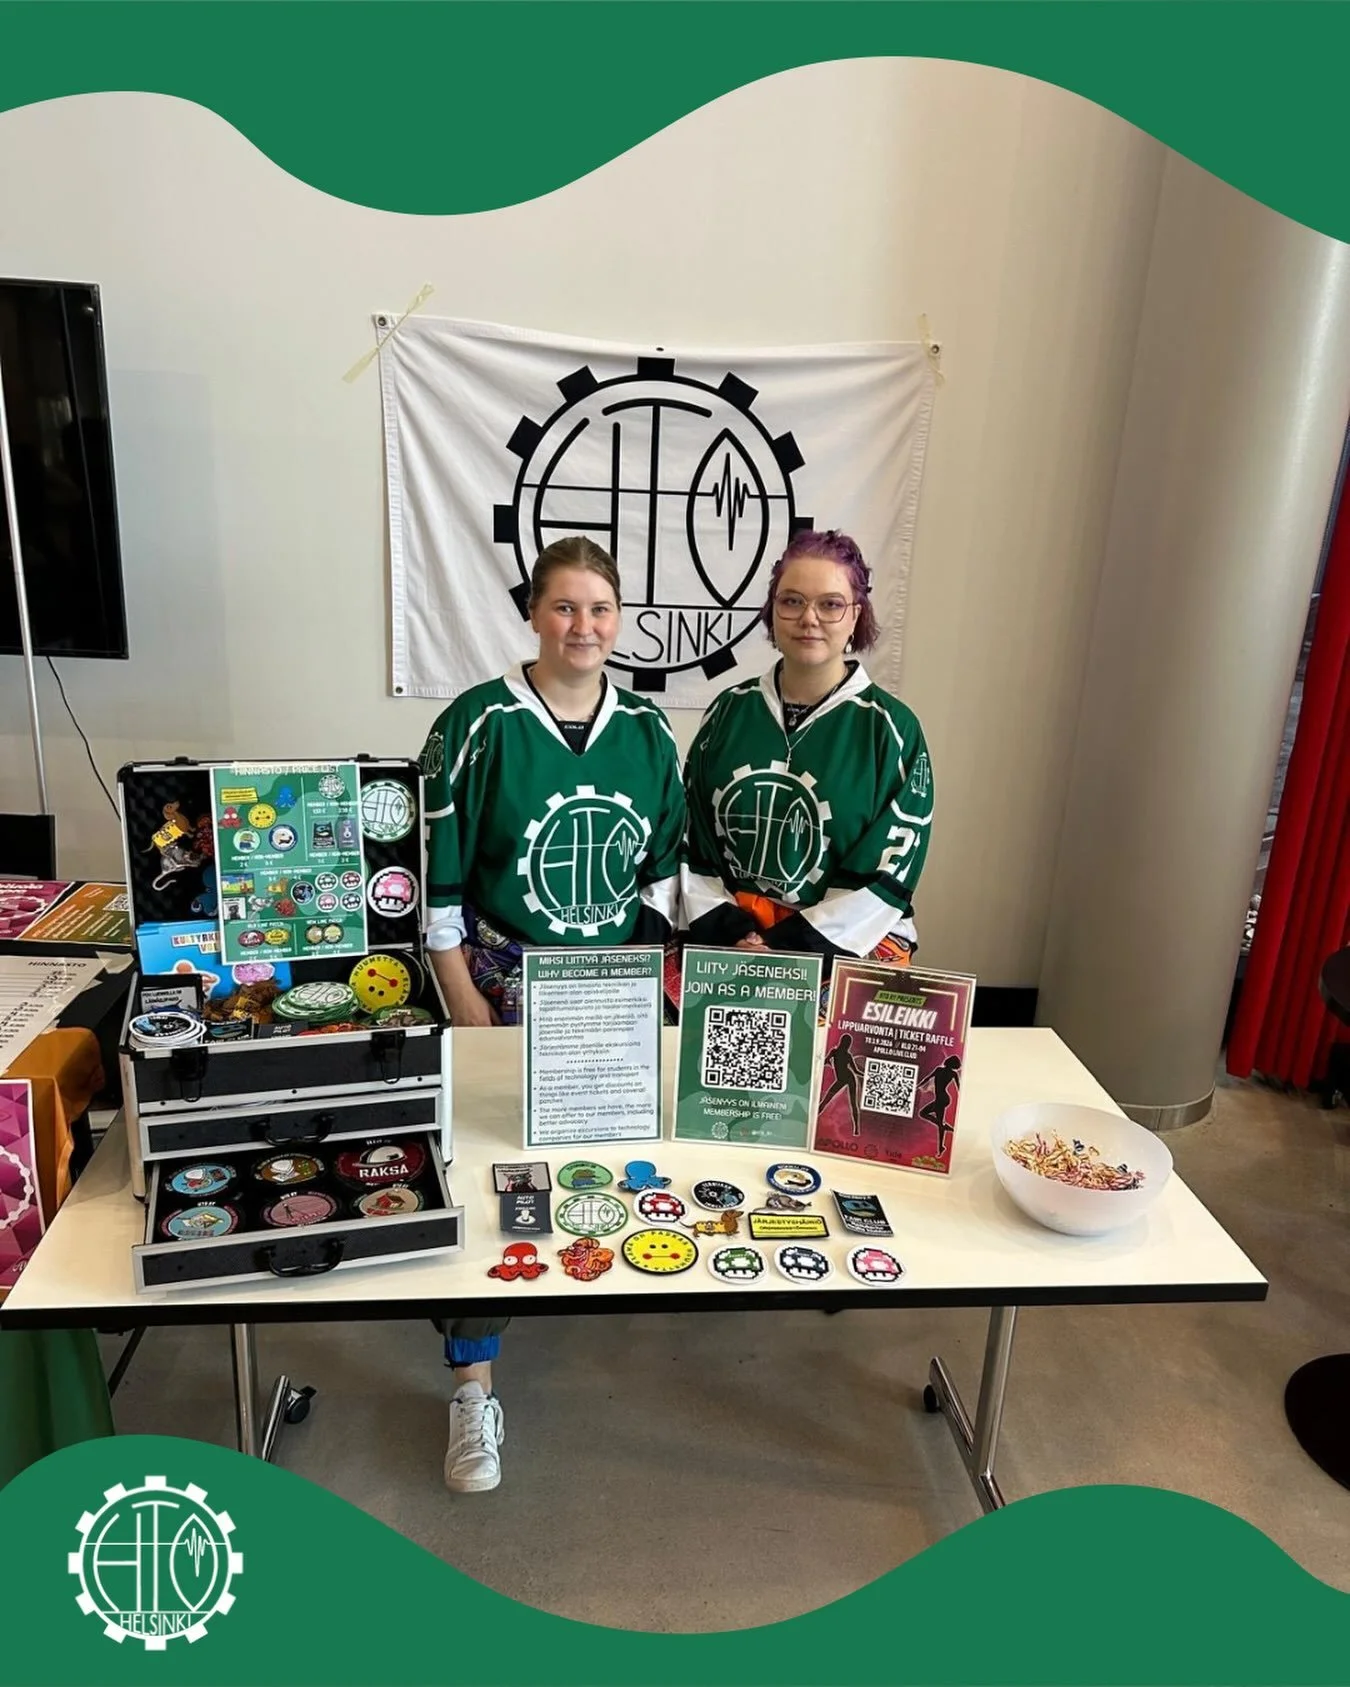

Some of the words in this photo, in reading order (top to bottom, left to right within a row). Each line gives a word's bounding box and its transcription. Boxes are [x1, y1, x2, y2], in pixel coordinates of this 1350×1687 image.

[612, 610, 733, 663] SINKI
[561, 904, 621, 927] HELSINKI
[539, 956, 564, 966] MIKSI
[696, 961, 728, 975] LIITY
[538, 969, 559, 978] WHY
[562, 968, 599, 978] BECOME
[601, 968, 608, 976] A
[610, 966, 652, 977] MEMBER?
[685, 981, 714, 994] JOIN
[718, 983, 736, 996] AS
[741, 984, 750, 997] A
[755, 986, 816, 1002] MEMBER!
[862, 1001, 938, 1030] ESILEIKKI
[838, 1020, 894, 1038] LIPPUARVONTA
[900, 1030, 925, 1042] TICKET
[926, 1033, 955, 1047] RAFFLE
[738, 1099, 750, 1108] ON
[703, 1107, 751, 1119] MEMBERSHIP
[359, 1164, 409, 1178] RAKSA
